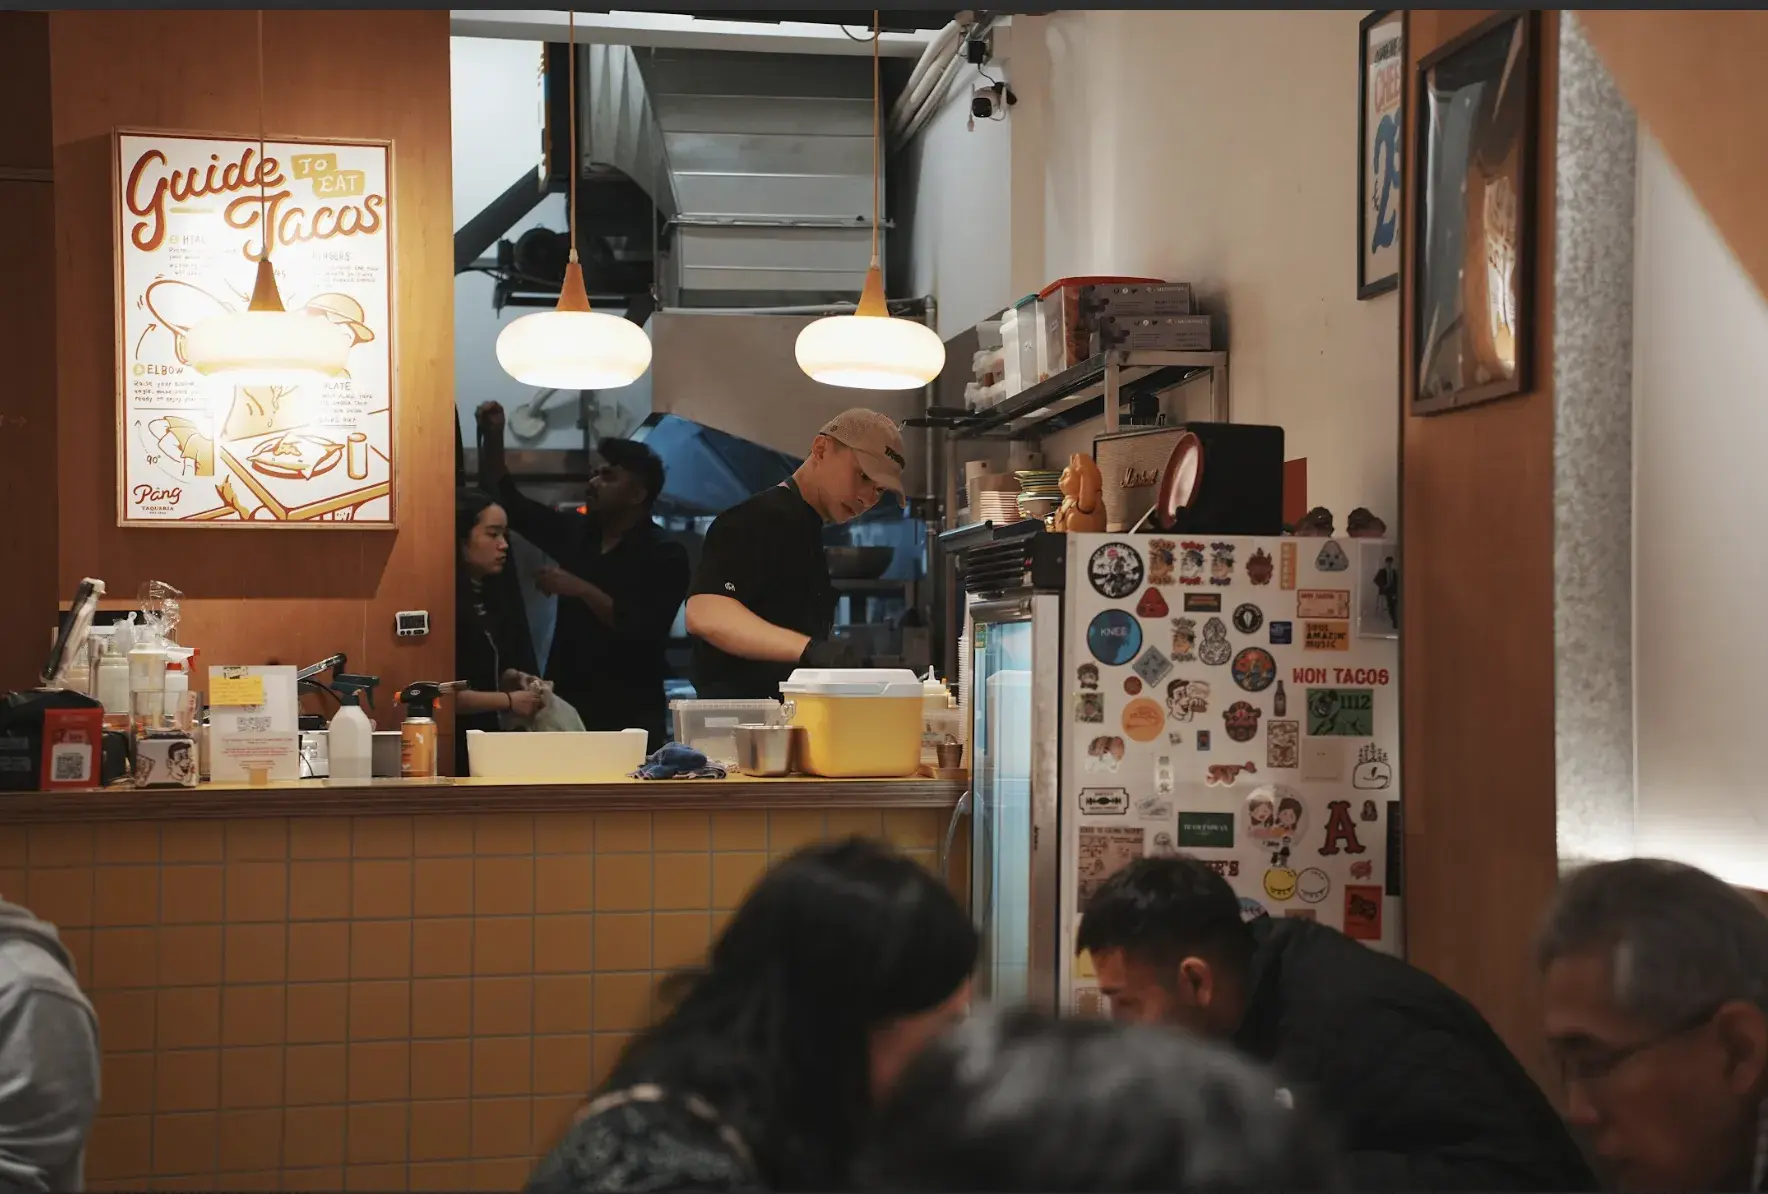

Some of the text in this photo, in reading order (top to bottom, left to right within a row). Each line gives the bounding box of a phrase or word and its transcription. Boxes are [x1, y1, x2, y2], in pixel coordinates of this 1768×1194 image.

[299, 158, 358, 192] TO EAT
[126, 148, 286, 251] Guide
[223, 190, 384, 262] Tacos
[147, 364, 184, 376] ELBOW
[146, 454, 161, 465] 90°
[1305, 640, 1336, 649] MUSIC
[1333, 667, 1389, 686] TACOS
